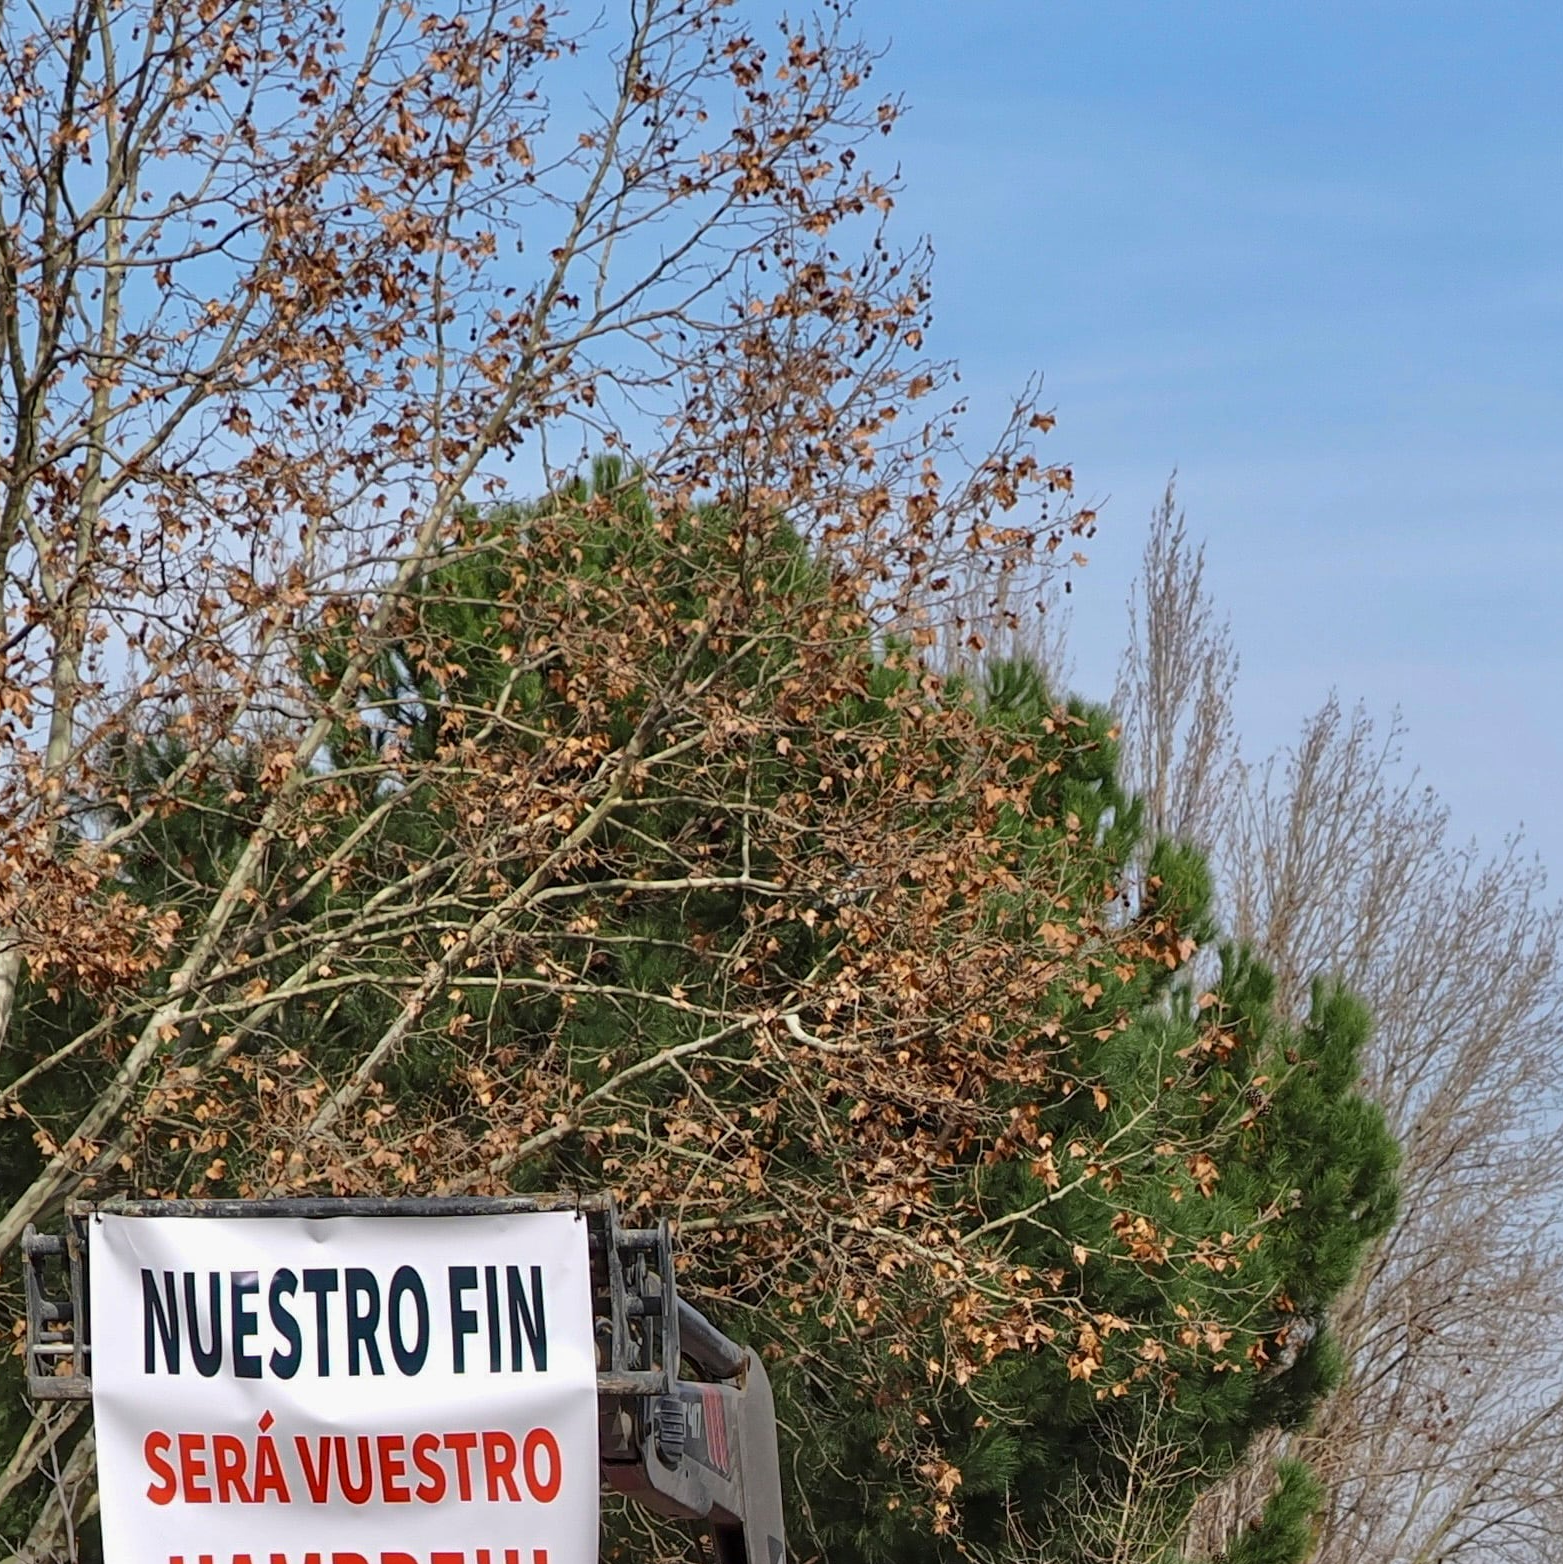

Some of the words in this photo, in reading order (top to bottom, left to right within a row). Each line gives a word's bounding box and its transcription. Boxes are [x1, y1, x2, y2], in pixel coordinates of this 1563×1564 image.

[140, 1264, 431, 1380] NUESTRO
[448, 1265, 549, 1375] FIN
[143, 1409, 292, 1506] SERÁ
[294, 1427, 563, 1505] VUESTRO
